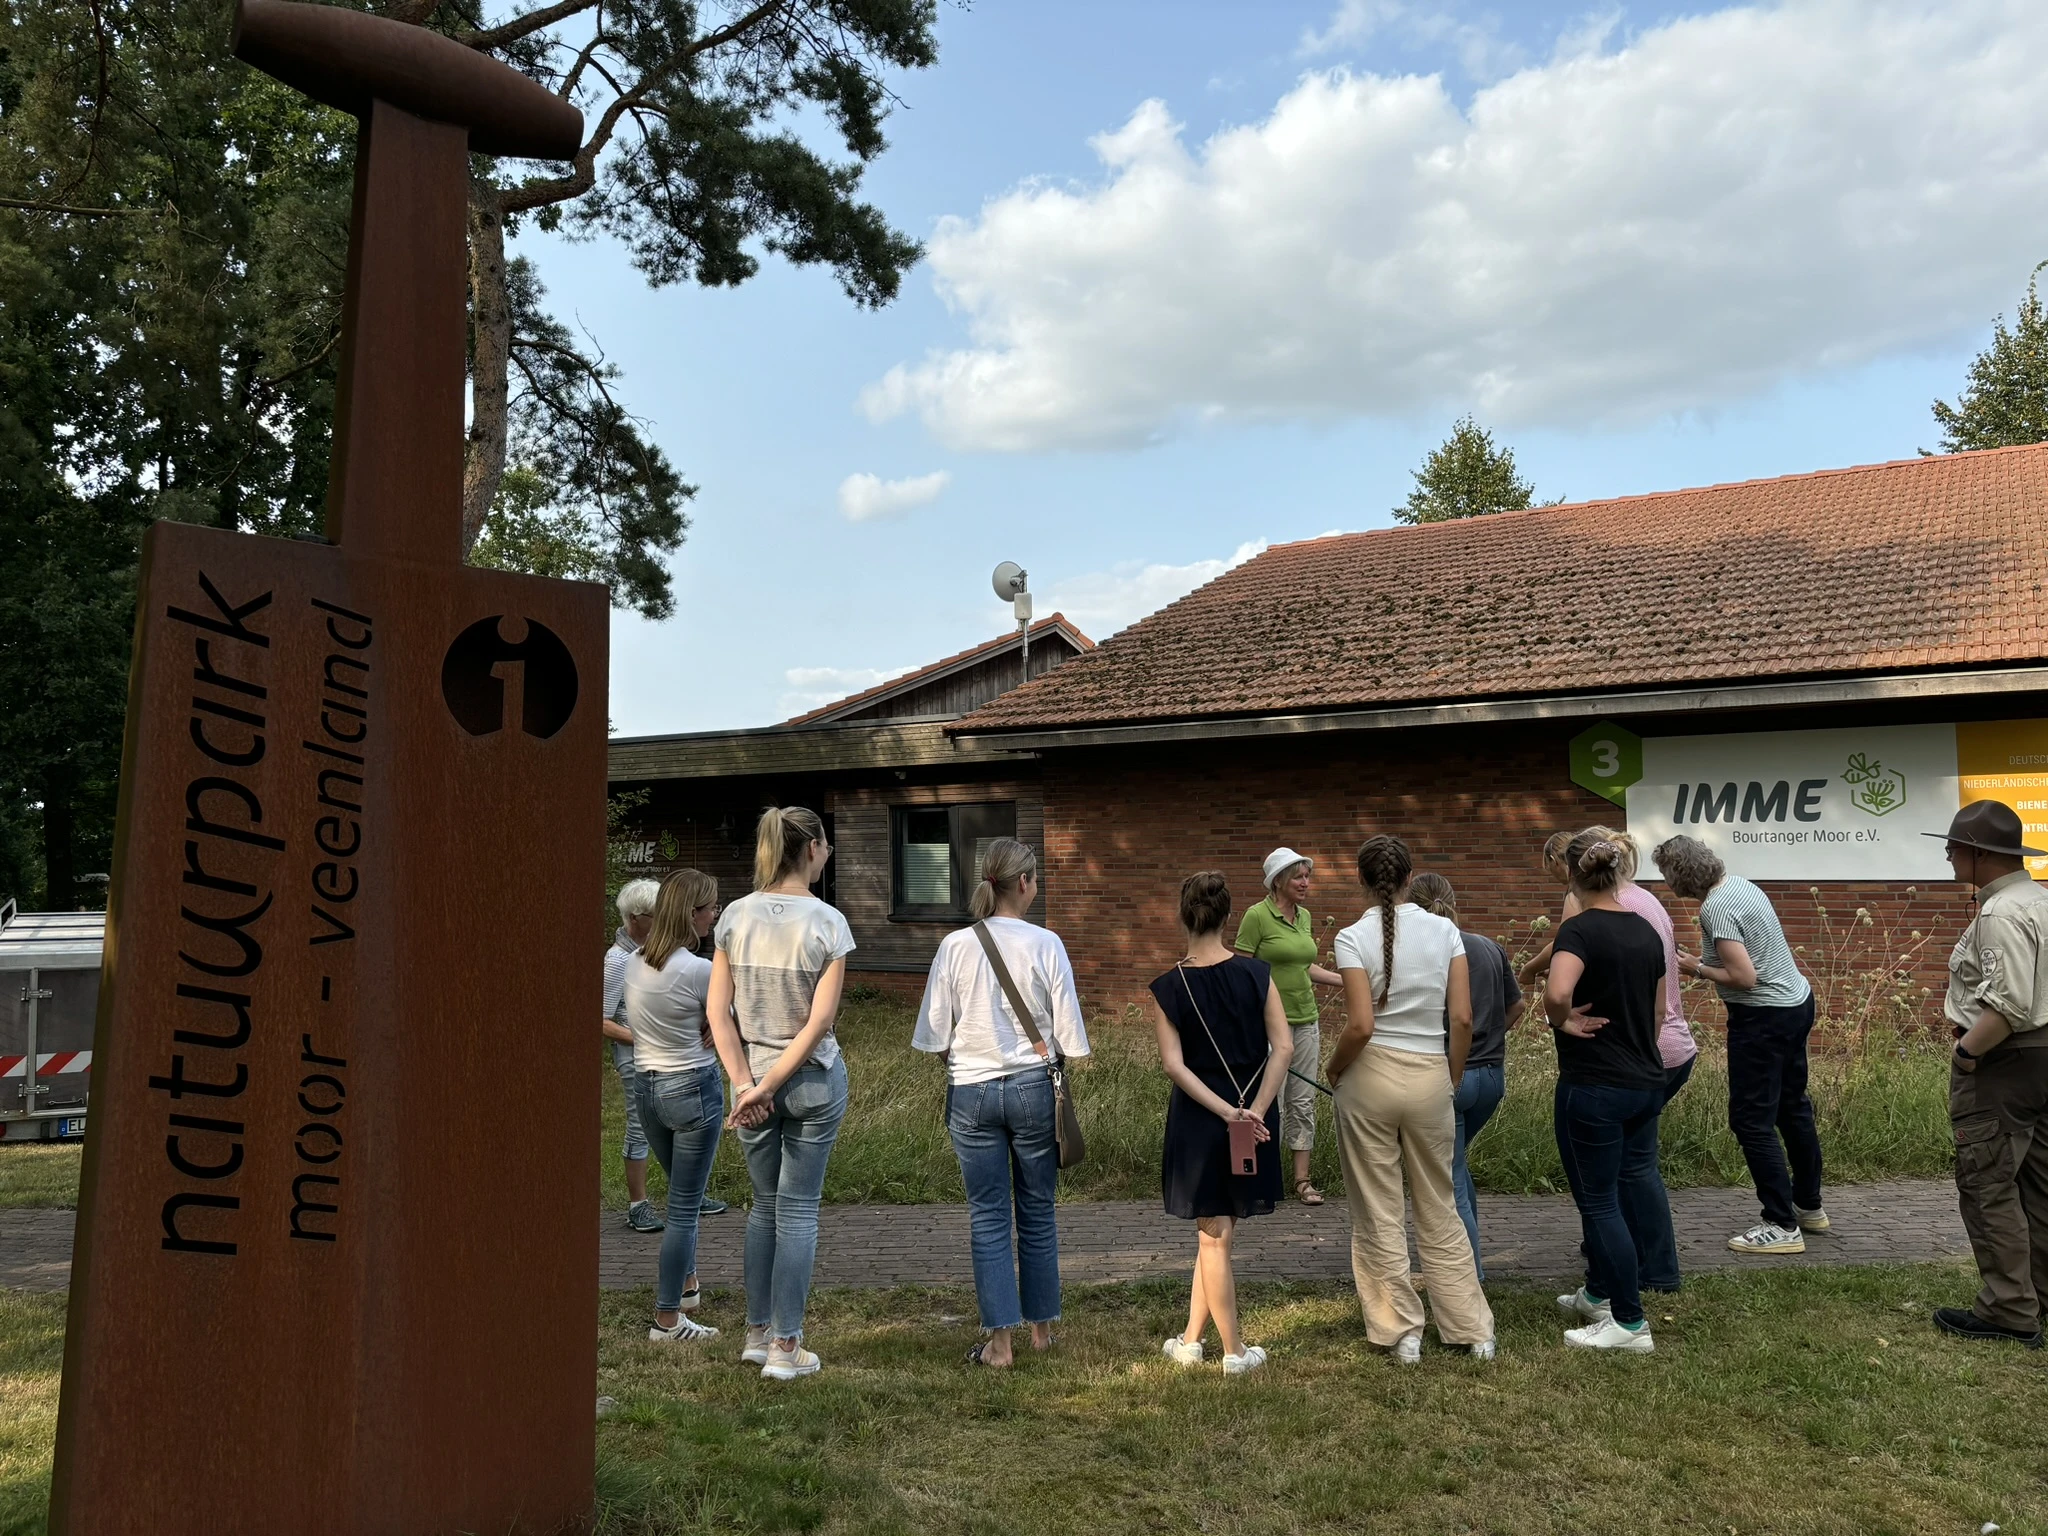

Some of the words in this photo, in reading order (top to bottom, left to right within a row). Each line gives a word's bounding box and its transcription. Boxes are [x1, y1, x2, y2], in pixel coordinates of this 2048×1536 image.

[301, 597, 374, 947] veenland
[1591, 740, 1621, 778] 3
[1673, 779, 1828, 824] IMME
[1732, 830, 1809, 845] Bourtanger
[1813, 829, 1851, 842] Moor
[1855, 828, 1880, 842] e.V.
[2023, 823, 2048, 832] NTRU
[288, 1033, 348, 1244] moor
